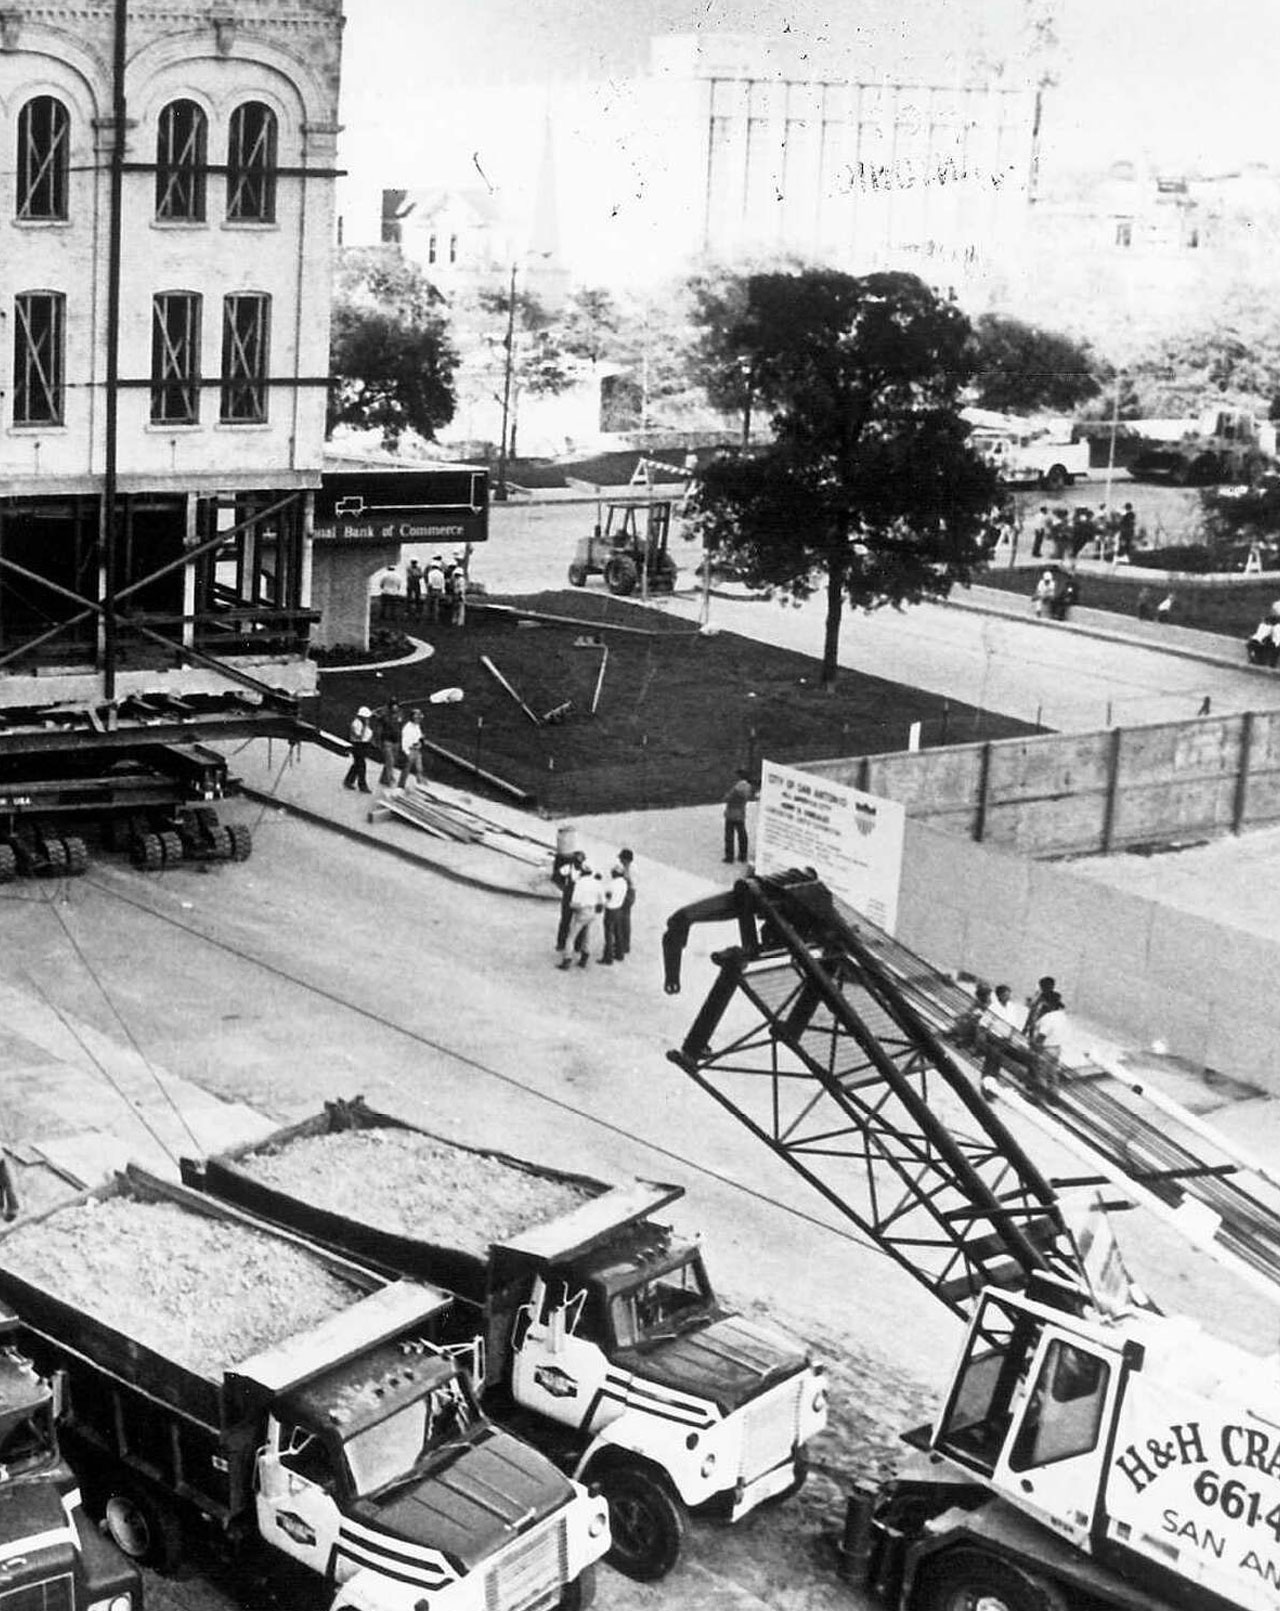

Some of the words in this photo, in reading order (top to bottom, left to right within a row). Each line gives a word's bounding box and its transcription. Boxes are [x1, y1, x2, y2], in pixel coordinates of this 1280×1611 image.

[344, 525, 374, 538] Bank
[382, 525, 394, 537] of
[400, 523, 464, 538] Commerce
[1115, 1422, 1208, 1494] H&H
[1162, 1509, 1225, 1558] SAN
